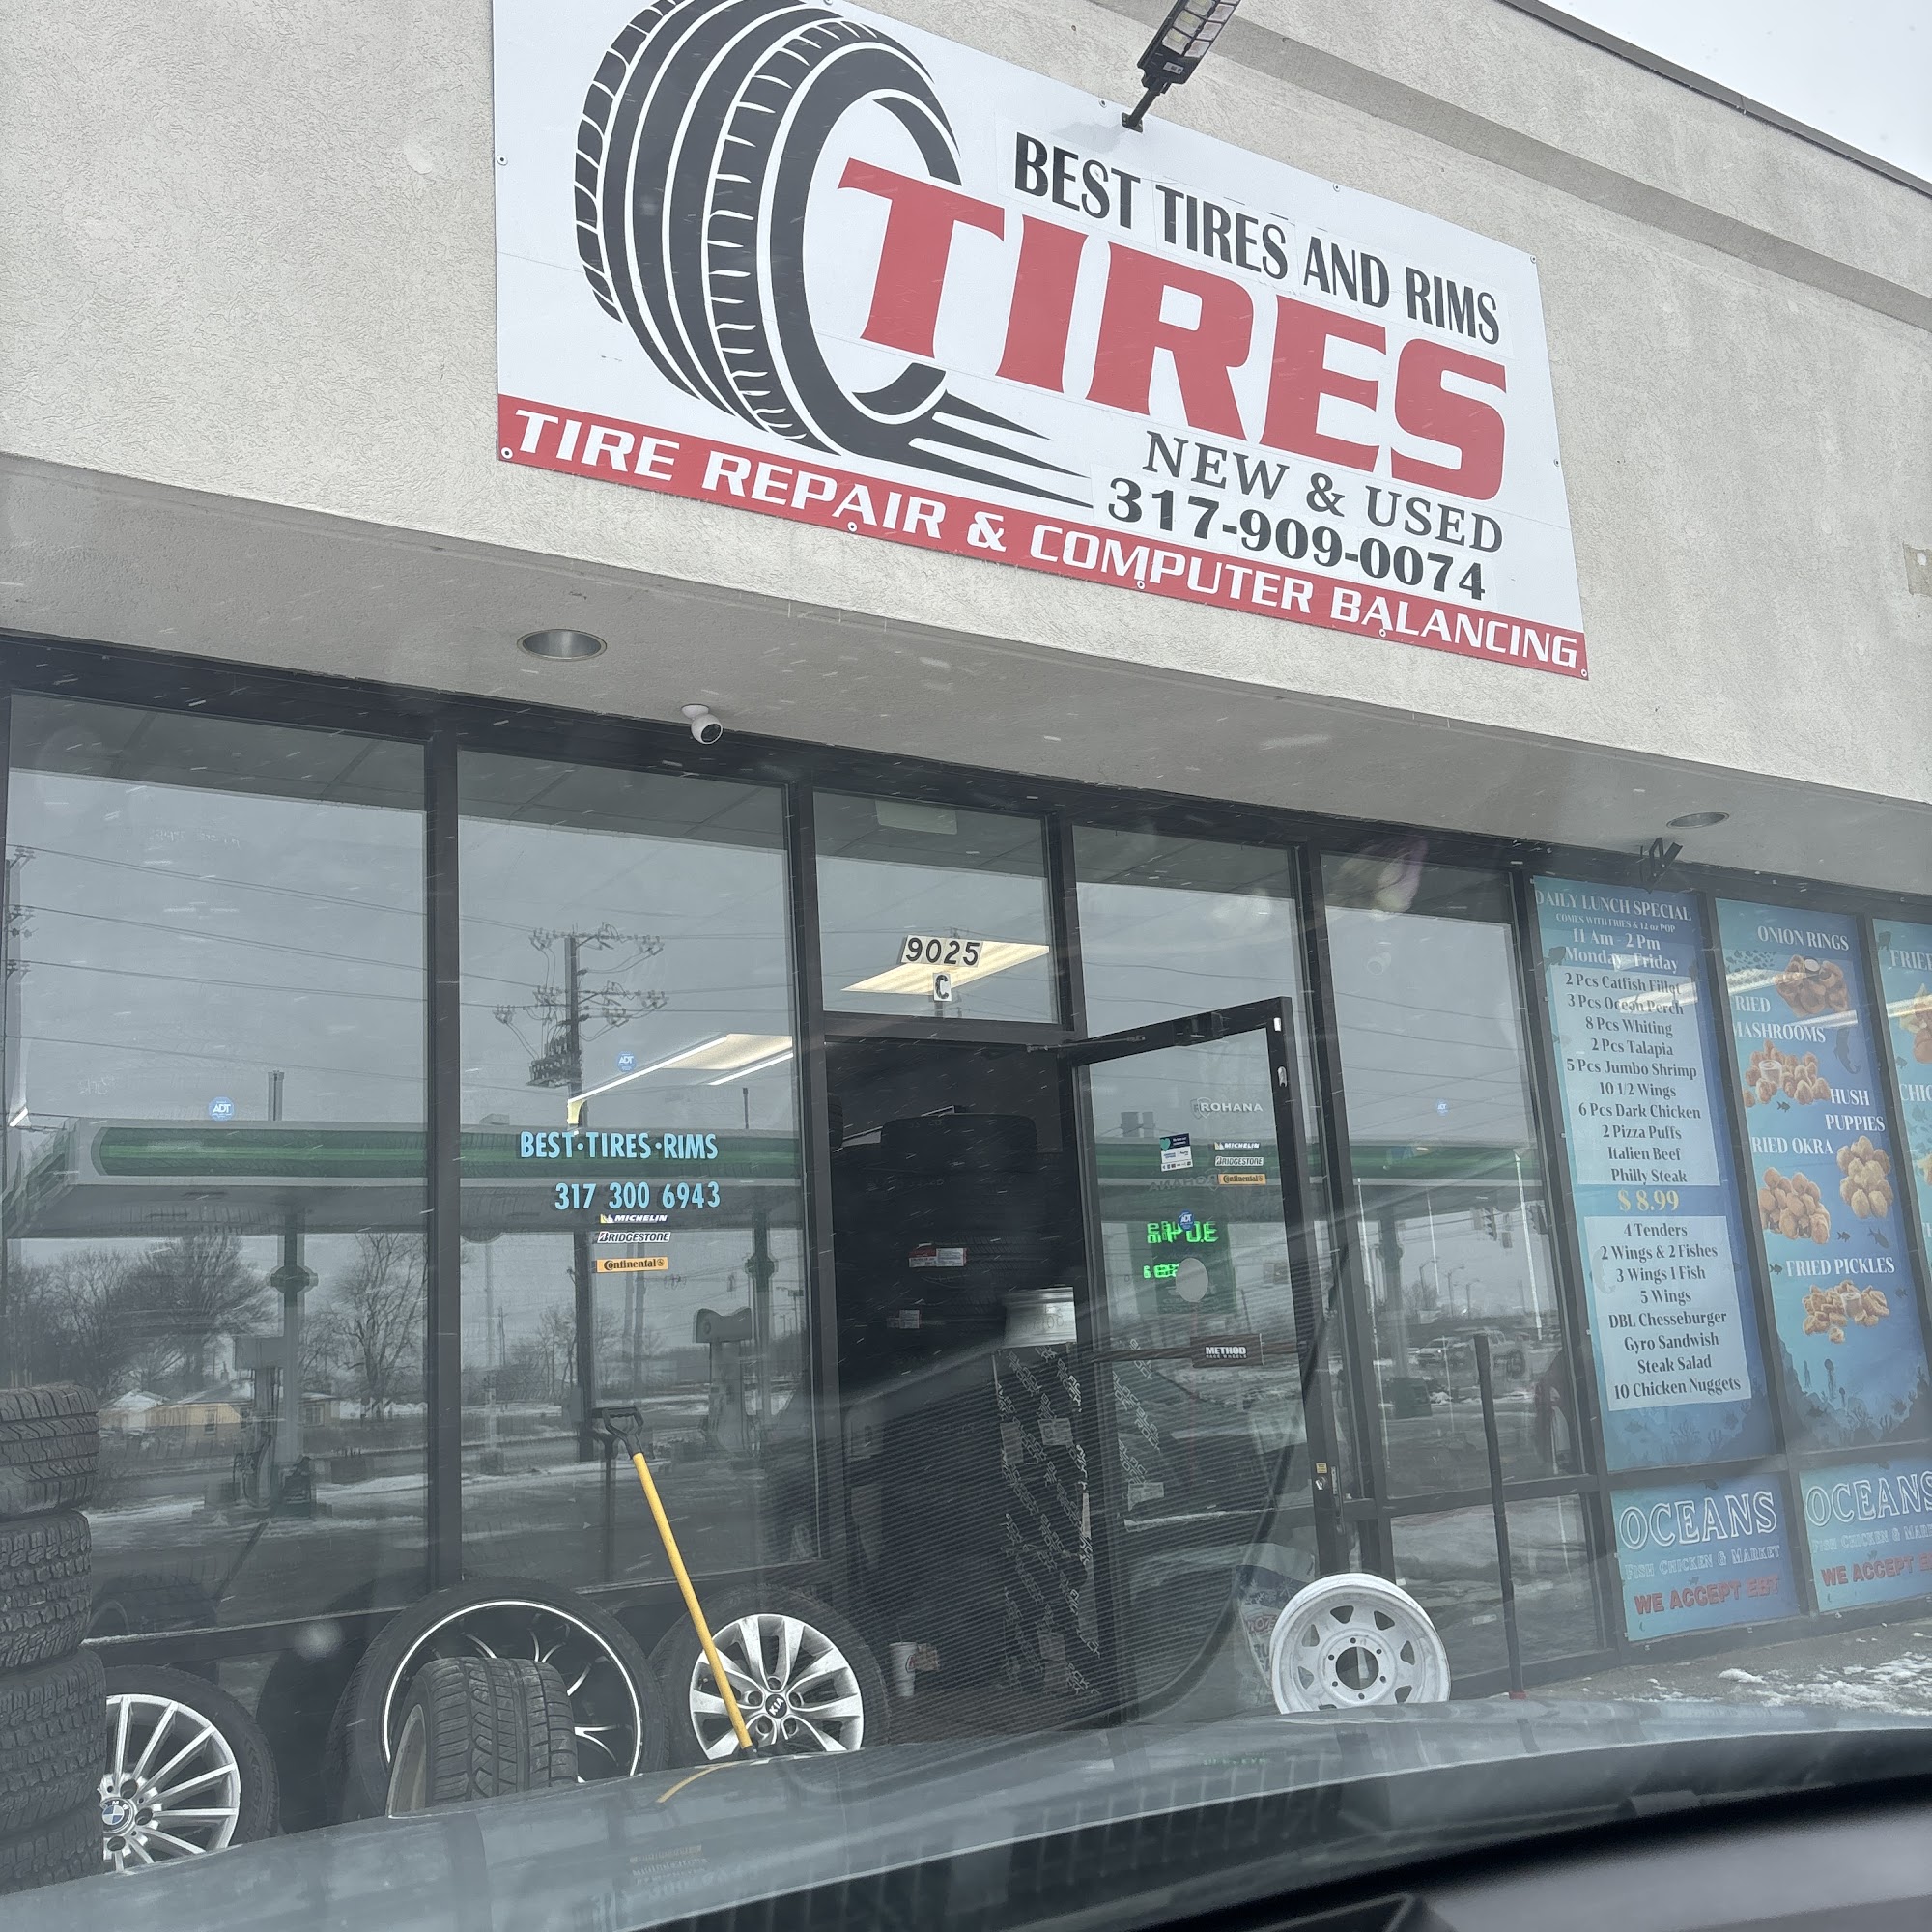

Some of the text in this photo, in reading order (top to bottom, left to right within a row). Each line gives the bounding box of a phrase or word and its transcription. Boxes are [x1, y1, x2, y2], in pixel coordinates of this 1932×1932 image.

[1015, 132, 1500, 345] BEST TIRES AND RIMS
[838, 157, 1507, 500] TIRES
[1143, 431, 1503, 554] NEW & USED
[516, 409, 1578, 669] TIRE REPAIR & COMPUTER BALANCING
[1108, 478, 1486, 601] 317-909-0074
[1535, 890, 1691, 921] DAILY LUNCH SPECIAL
[1556, 913, 1585, 924] COMES
[1585, 915, 1608, 926] WITH
[1608, 918, 1632, 929] FRIES
[1633, 921, 1638, 929] &
[1640, 922, 1649, 930] 12
[1661, 924, 1676, 934] POP
[1573, 927, 1585, 944] 11
[1590, 929, 1614, 946] Am
[1625, 932, 1634, 948] 2
[1636, 934, 1661, 951] Pm
[1757, 925, 1850, 952] ONION RINGS
[905, 937, 980, 966] 9025
[1566, 946, 1623, 972] Monday
[1634, 952, 1678, 974] Friday
[935, 974, 949, 1000] C
[1565, 972, 1574, 985] 2
[1576, 974, 1599, 988] Pcs
[1602, 975, 1646, 992] Catfish
[1568, 993, 1684, 1015] 3 Pcs Ocean Perch
[1585, 1016, 1674, 1038] 8 Pcs Whiting
[1591, 1037, 1674, 1059] 2 Pcs Talapia
[618, 1055, 635, 1064] ADT
[1567, 1058, 1697, 1080] 5 Pcs Jumbo Shrimp
[1600, 1081, 1677, 1100] 10 1/2 Wings
[1830, 1088, 1870, 1106] HUSH
[213, 1103, 232, 1113] ADT
[1200, 1102, 1264, 1113] ROHANA
[1578, 1102, 1701, 1119] 6 Pcs Dark Chicken
[1603, 1124, 1682, 1140] 2 Pizza Puffs
[1825, 1113, 1886, 1132] PUPPIES
[521, 1130, 719, 1160] BEST TIRES RIMS
[1607, 1146, 1682, 1161] Italien Beef
[1792, 1137, 1834, 1155] OKRA
[1216, 1156, 1263, 1166] BRIDGESTONE
[1222, 1175, 1259, 1184] Continental
[1610, 1167, 1688, 1185] Philly Steak
[554, 1180, 721, 1210] 317 300 6943
[1617, 1189, 1679, 1212] $ 8.99
[1180, 1213, 1193, 1223] ADT
[599, 1232, 669, 1242] BRIDGESTONE
[1624, 1222, 1688, 1236] 4 Tenders
[1600, 1243, 1719, 1264] 2 Wings & 2 Fishes
[604, 1258, 657, 1271] Continental
[1616, 1265, 1706, 1285] 3 Wings 1 Fish
[1785, 1256, 1895, 1277] FRIED PICKLES
[1640, 1289, 1692, 1307] 5 Wings
[1608, 1311, 1727, 1329] DBL Chesseburger
[1205, 1346, 1247, 1355] METHOD
[1624, 1331, 1719, 1354] Gyro Sandwish
[1637, 1354, 1712, 1375] Steak Salad
[1614, 1377, 1741, 1400] 10 Chicken Nuggets
[1619, 1491, 1777, 1550] OCEANS
[1810, 1537, 1838, 1554] FISH
[1840, 1530, 1889, 1549] CHICKEN
[1891, 1527, 1901, 1542] &
[1625, 1545, 1780, 1580] FISH CHICKEN & MARKET
[1821, 1564, 1849, 1587] WE
[1852, 1555, 1914, 1583] ACCEPT
[1634, 1573, 1780, 1616] WE ACCEPT EBT
[768, 1697, 784, 1716] KIA
